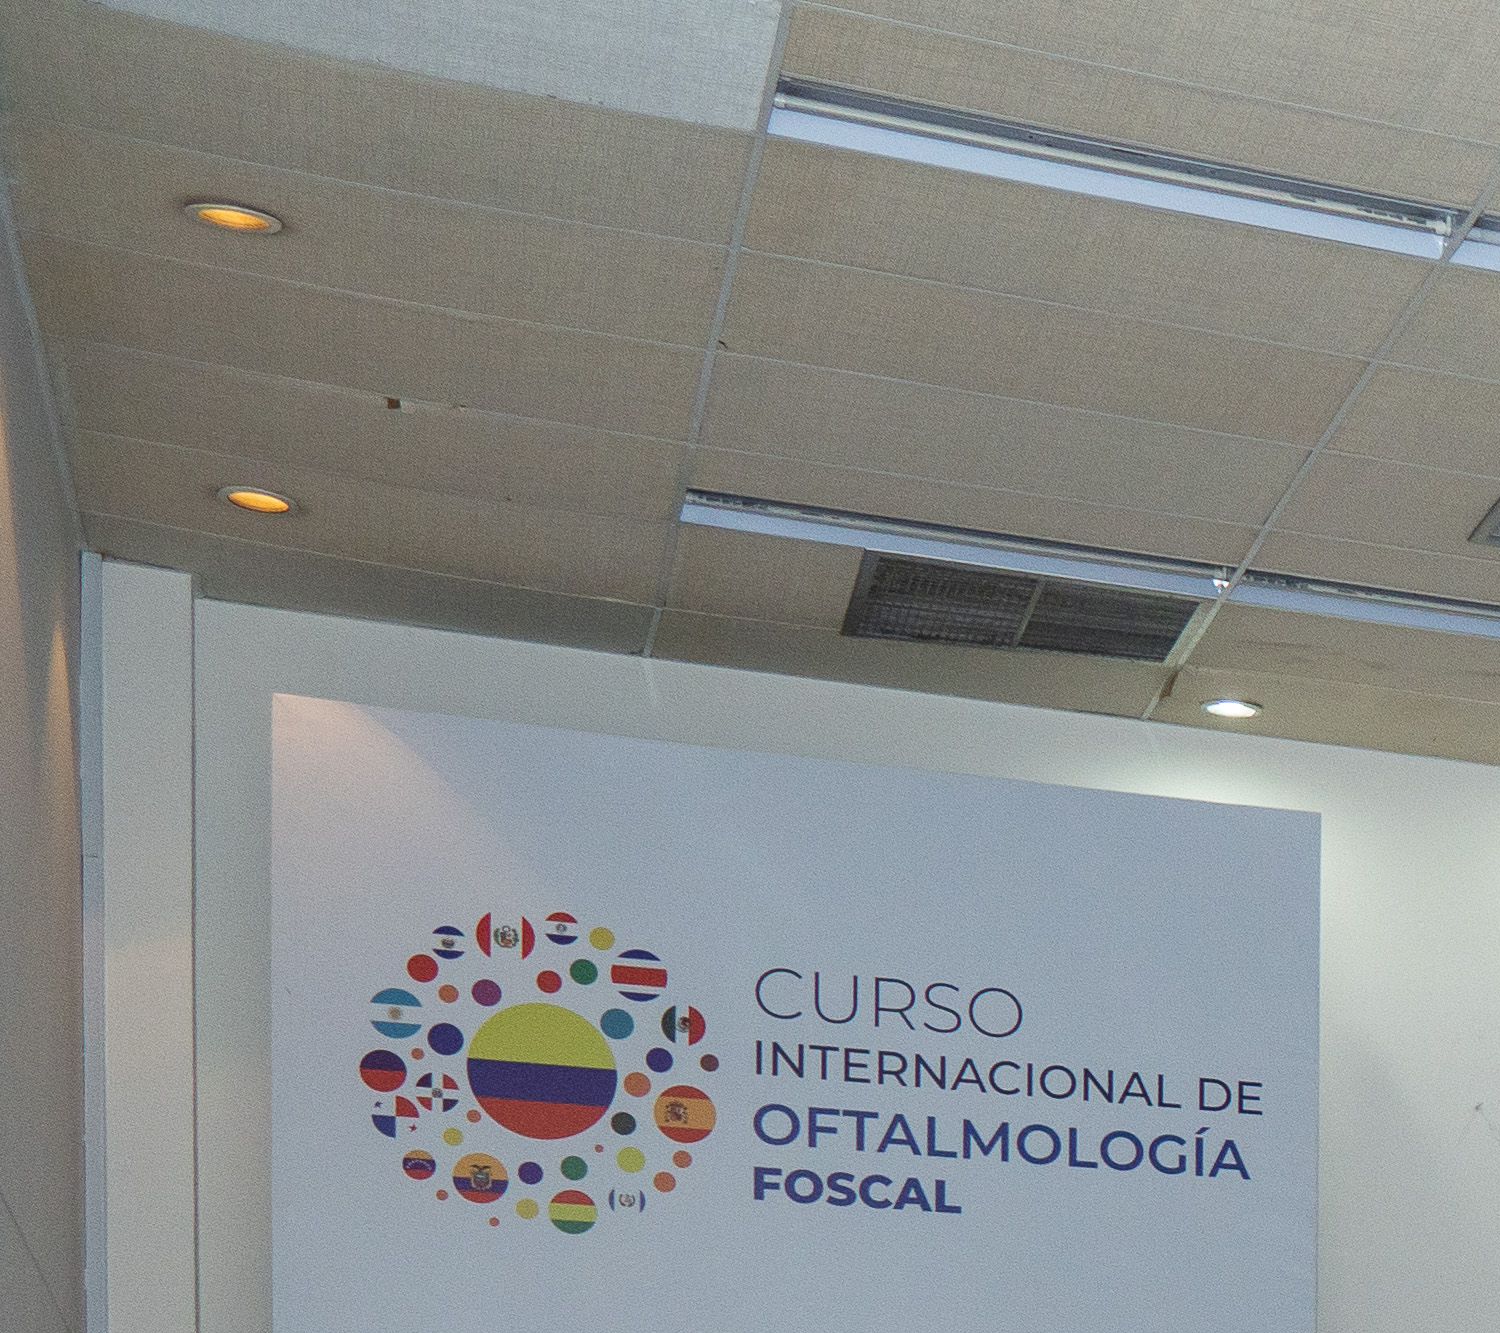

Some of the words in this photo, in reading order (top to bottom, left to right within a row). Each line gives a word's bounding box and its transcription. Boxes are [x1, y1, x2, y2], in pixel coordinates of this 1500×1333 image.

[755, 967, 1023, 1038] CURSO
[755, 1040, 1169, 1109] INTERNACIONAL
[1198, 1077, 1263, 1116] DE
[753, 1103, 1250, 1180] OFTALMOLOGÍA
[753, 1166, 961, 1214] FOSCAL
